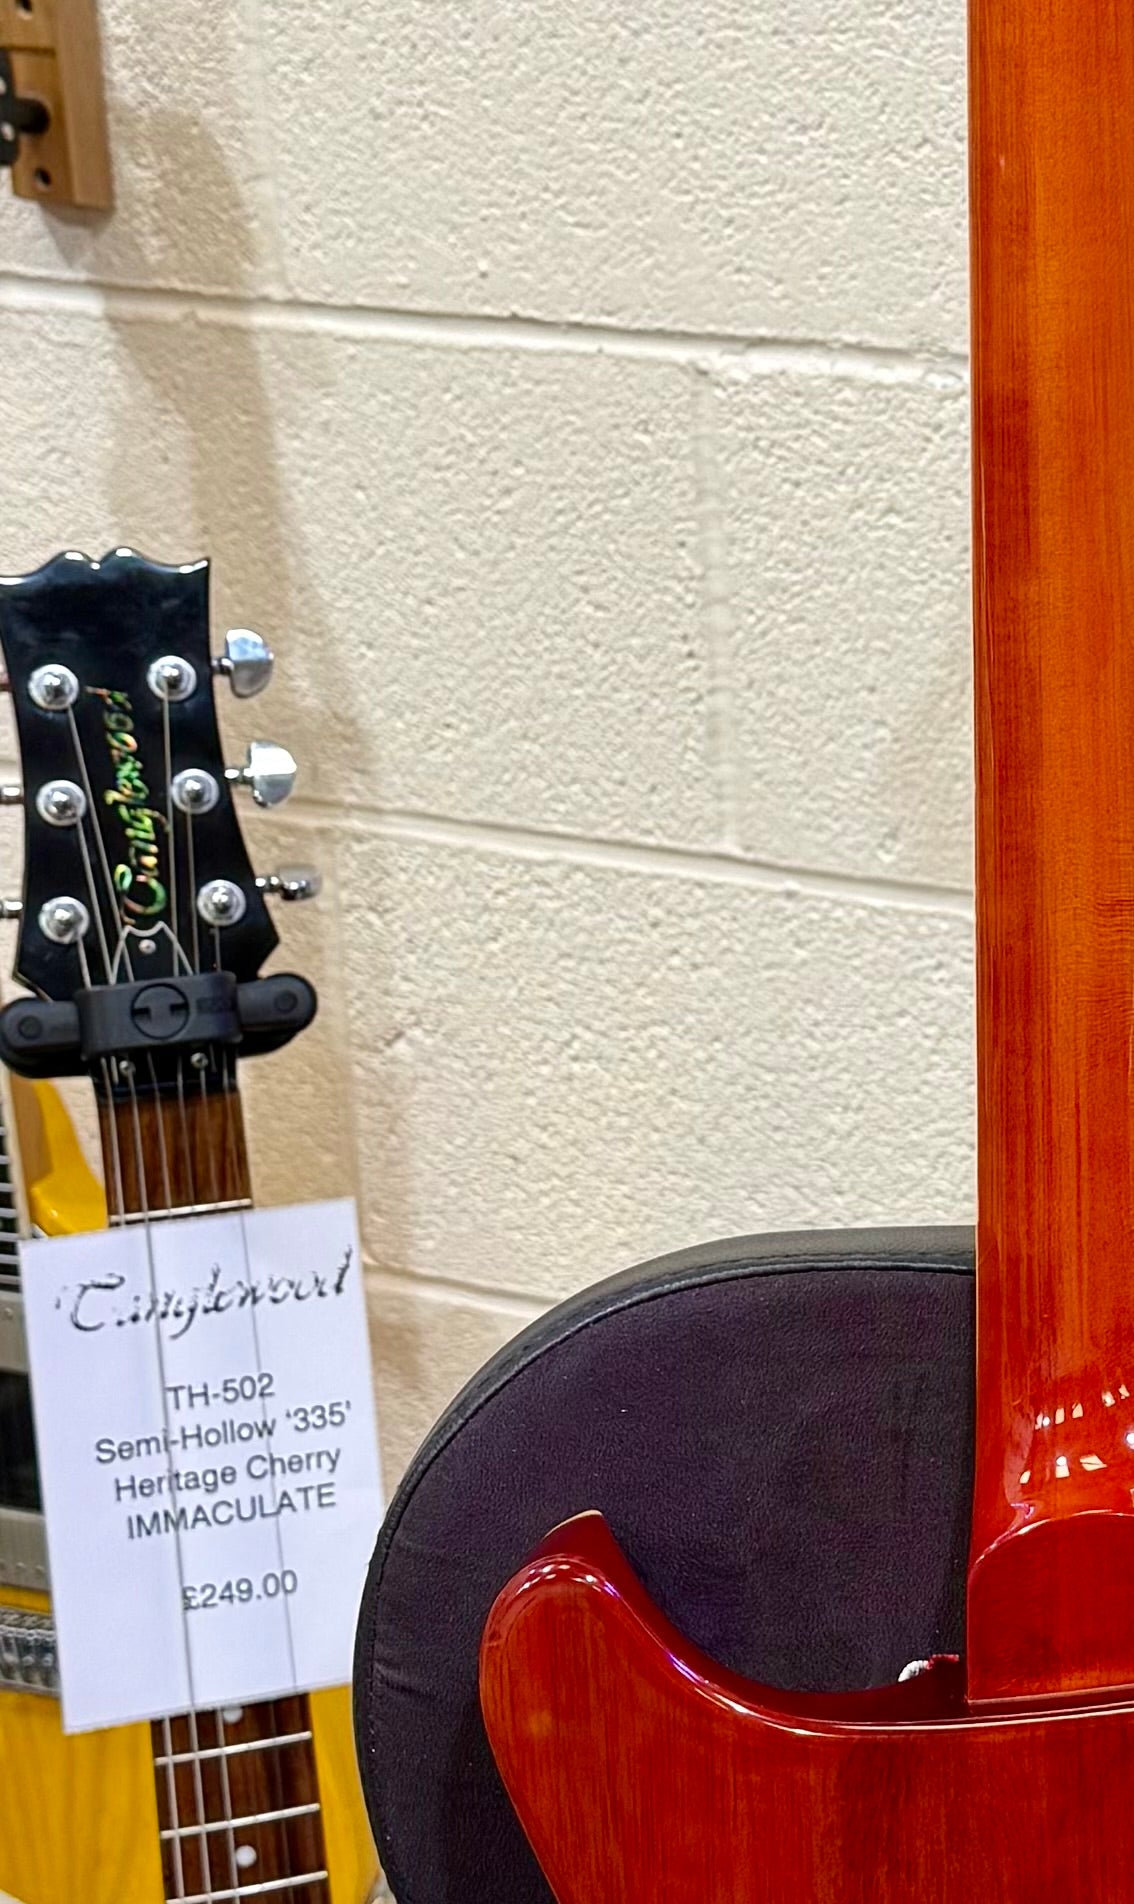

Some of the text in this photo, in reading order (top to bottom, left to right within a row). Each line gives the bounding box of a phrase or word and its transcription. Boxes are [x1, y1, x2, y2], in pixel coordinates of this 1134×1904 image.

[55, 1244, 353, 1340] Tanglewood
[165, 1372, 276, 1411] TH-502
[94, 1399, 351, 1465] Semi-Hollow '335'
[114, 1448, 341, 1502] Heritage Cherry
[126, 1482, 337, 1540] IMMACULATE
[182, 1569, 298, 1611] £249.00
